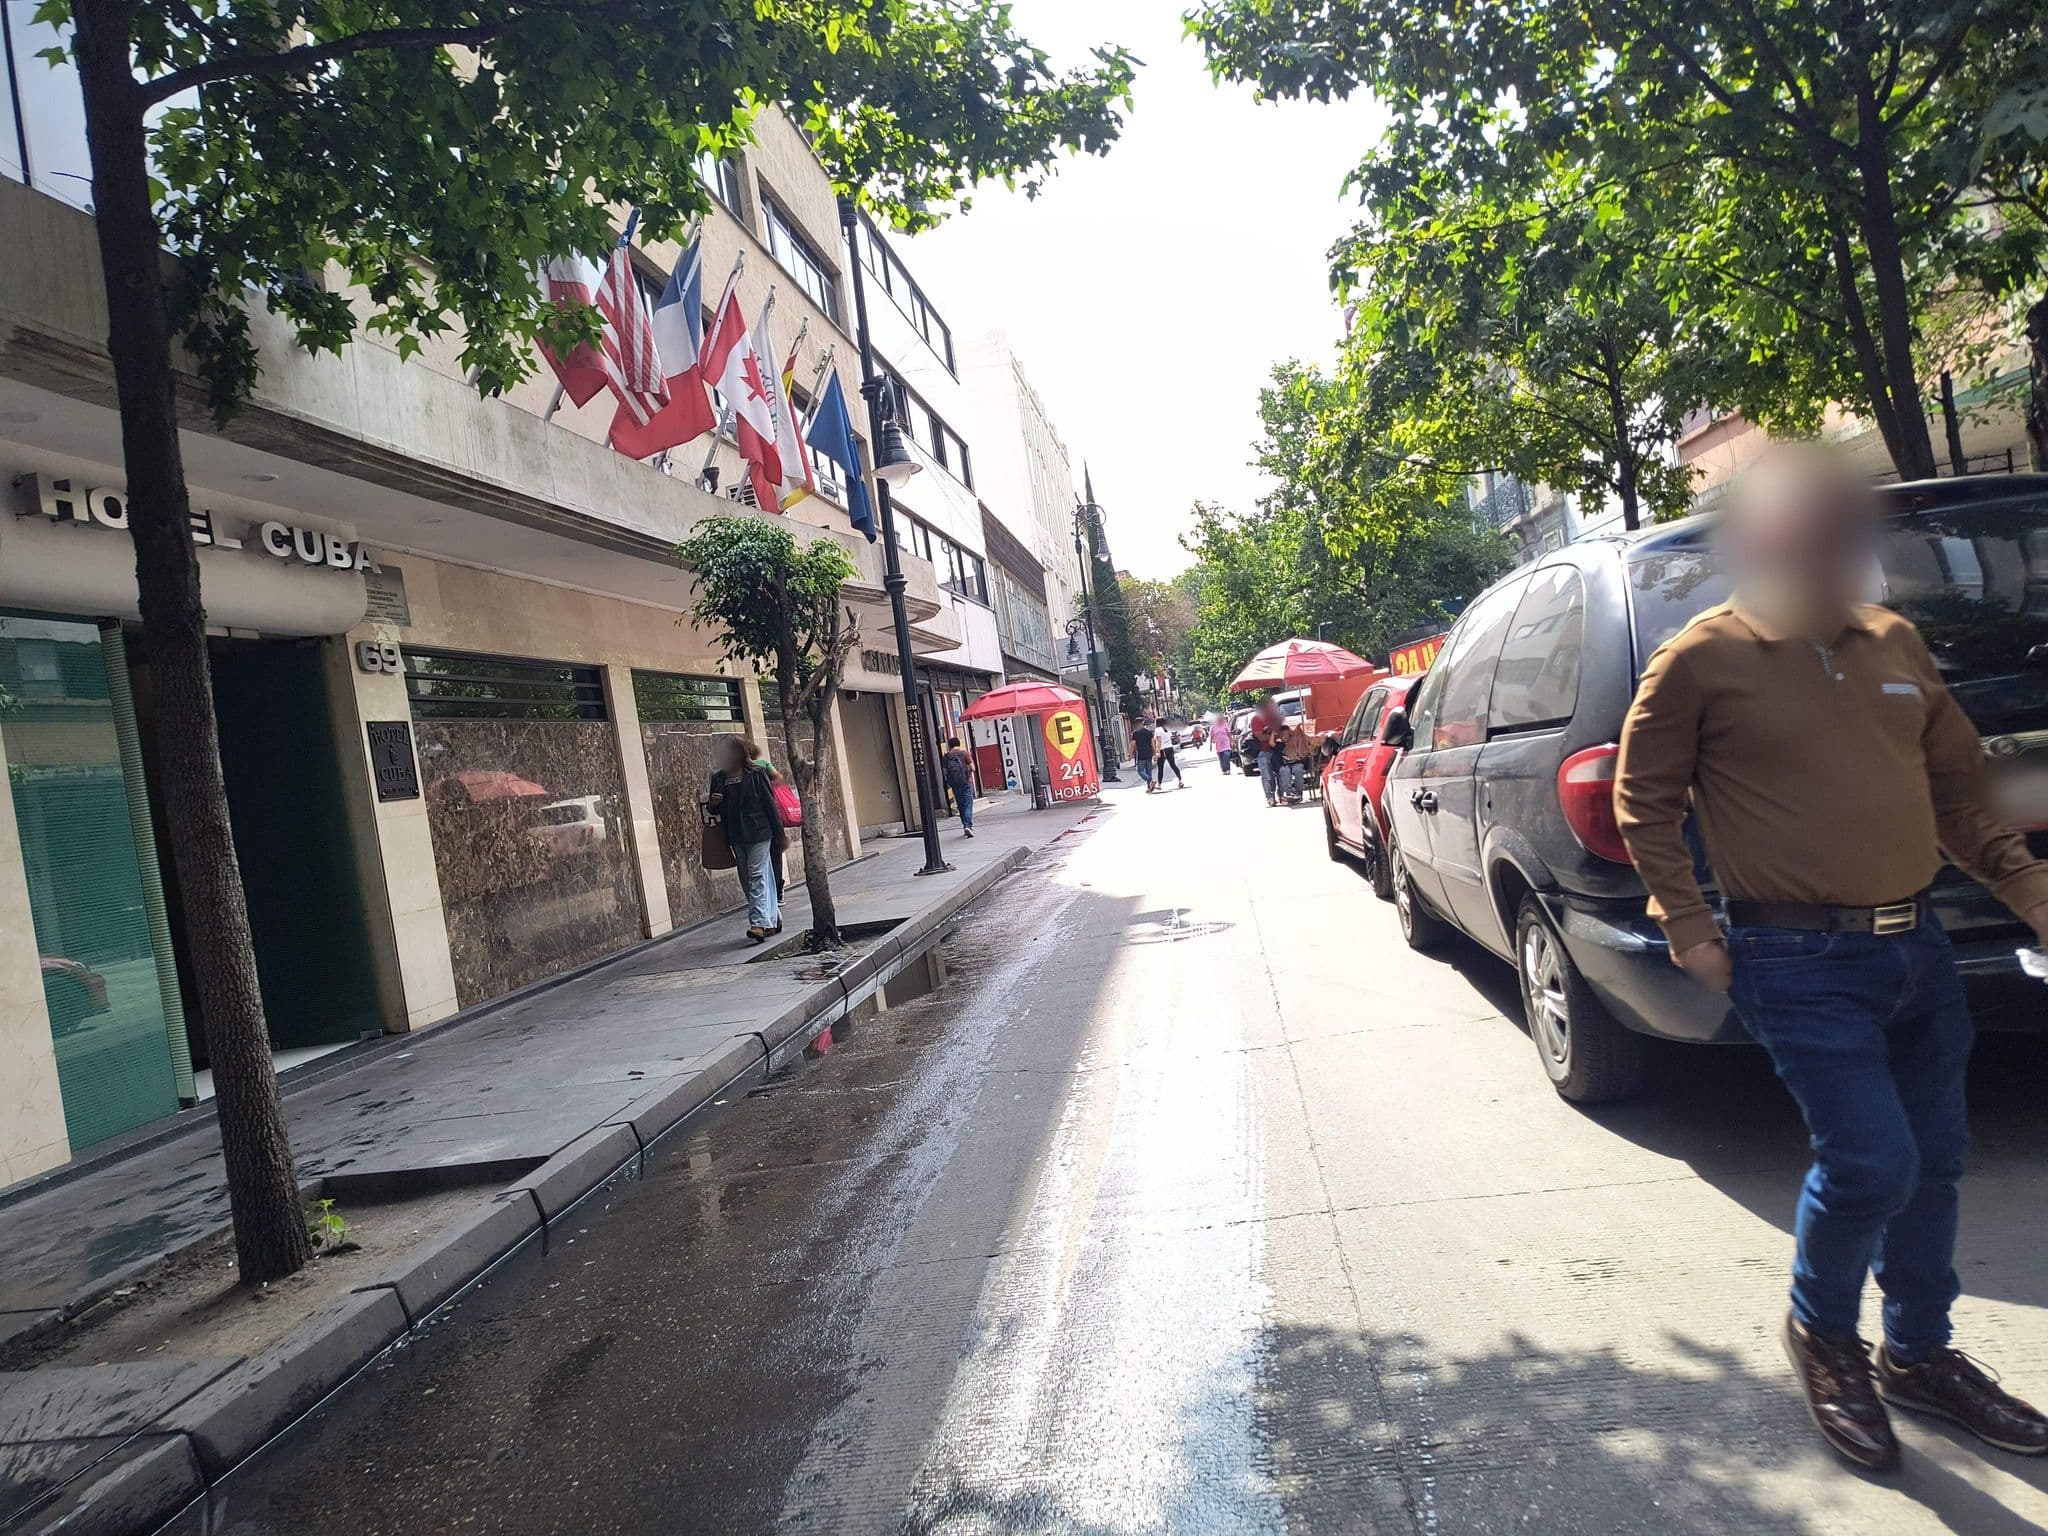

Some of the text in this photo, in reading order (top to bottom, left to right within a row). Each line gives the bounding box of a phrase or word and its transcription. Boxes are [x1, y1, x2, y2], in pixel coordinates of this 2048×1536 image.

[36, 472, 382, 575] HOEL CUBA
[358, 641, 401, 673] 69
[372, 727, 409, 745] HOTEL
[1055, 716, 1075, 745] E
[999, 718, 1016, 779] ALIDA
[381, 767, 414, 782] CUBA
[1060, 760, 1085, 781] 24
[1055, 782, 1099, 800] HORAS
